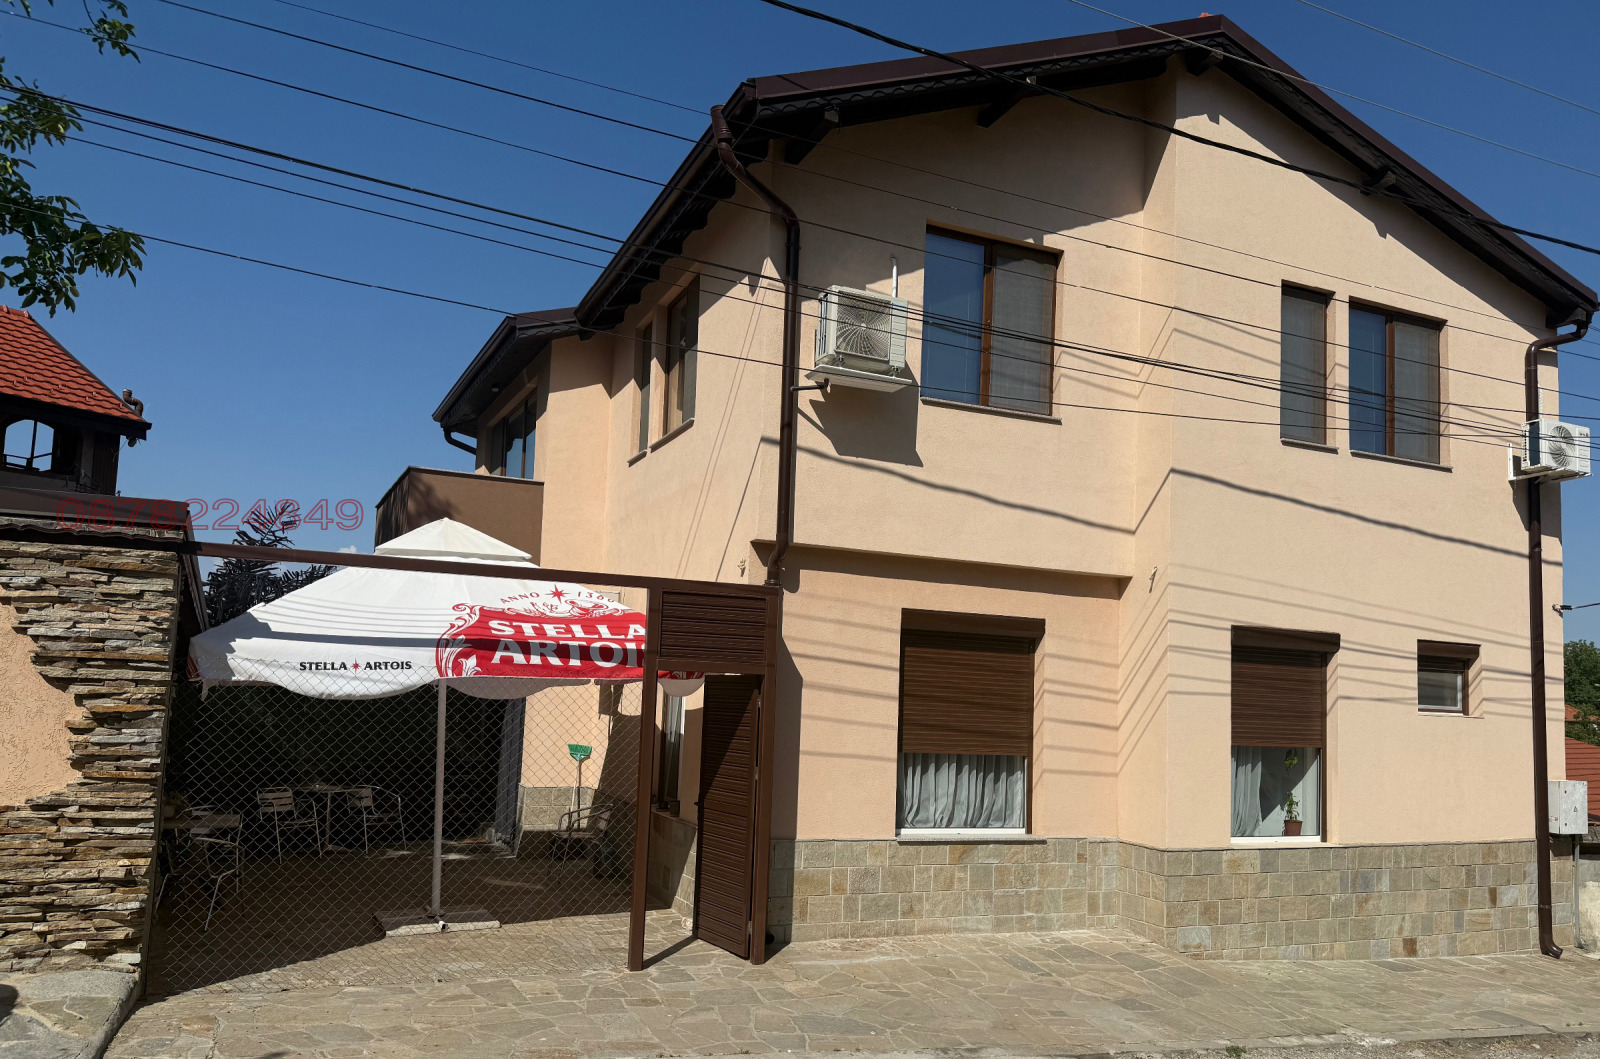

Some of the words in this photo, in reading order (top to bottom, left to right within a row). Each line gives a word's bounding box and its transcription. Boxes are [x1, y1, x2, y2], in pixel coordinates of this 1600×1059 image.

[500, 591, 540, 604] ANNO
[488, 620, 646, 639] STELLA
[490, 639, 646, 668] ARTOI
[299, 661, 348, 671] STELLA
[363, 660, 412, 671] ARTOIS
